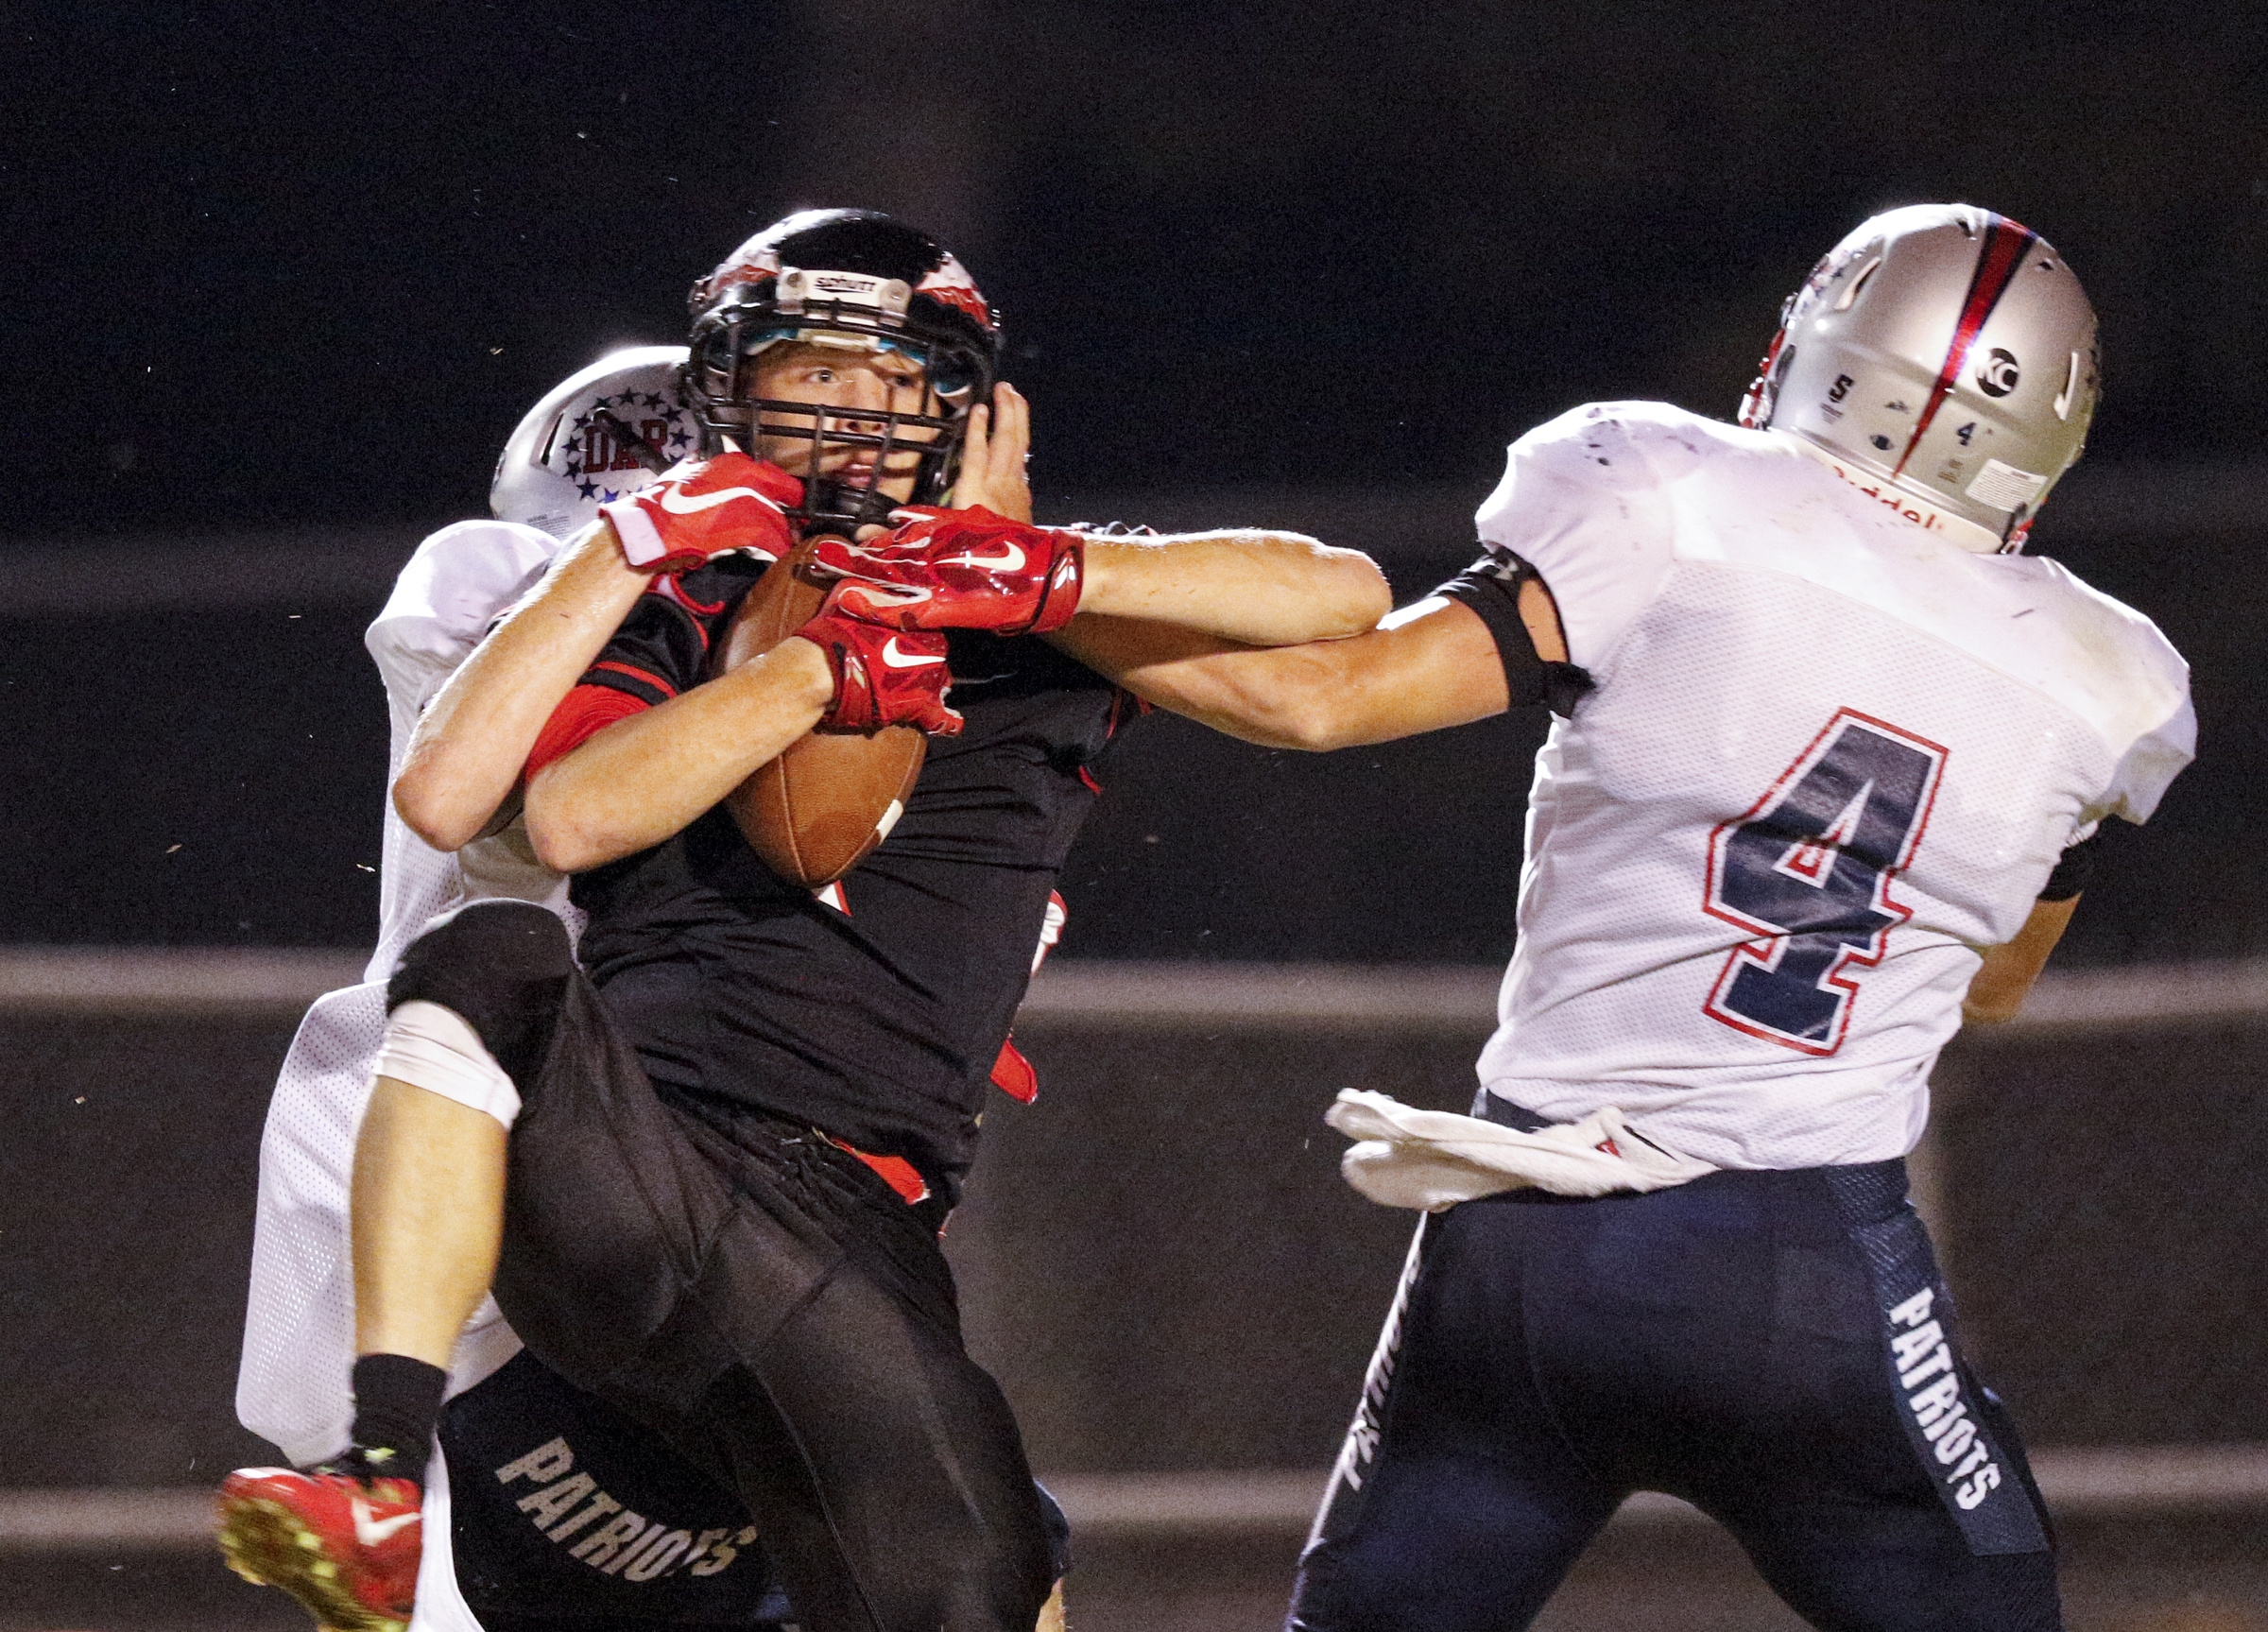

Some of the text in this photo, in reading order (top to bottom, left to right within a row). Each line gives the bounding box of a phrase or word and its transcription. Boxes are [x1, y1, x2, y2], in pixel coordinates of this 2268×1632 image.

[1957, 422, 1977, 446] 4
[1703, 706, 1950, 1057] 4
[1890, 1287, 2002, 1510] PATRIOTS
[495, 1435, 758, 1582] PATRIOTS
